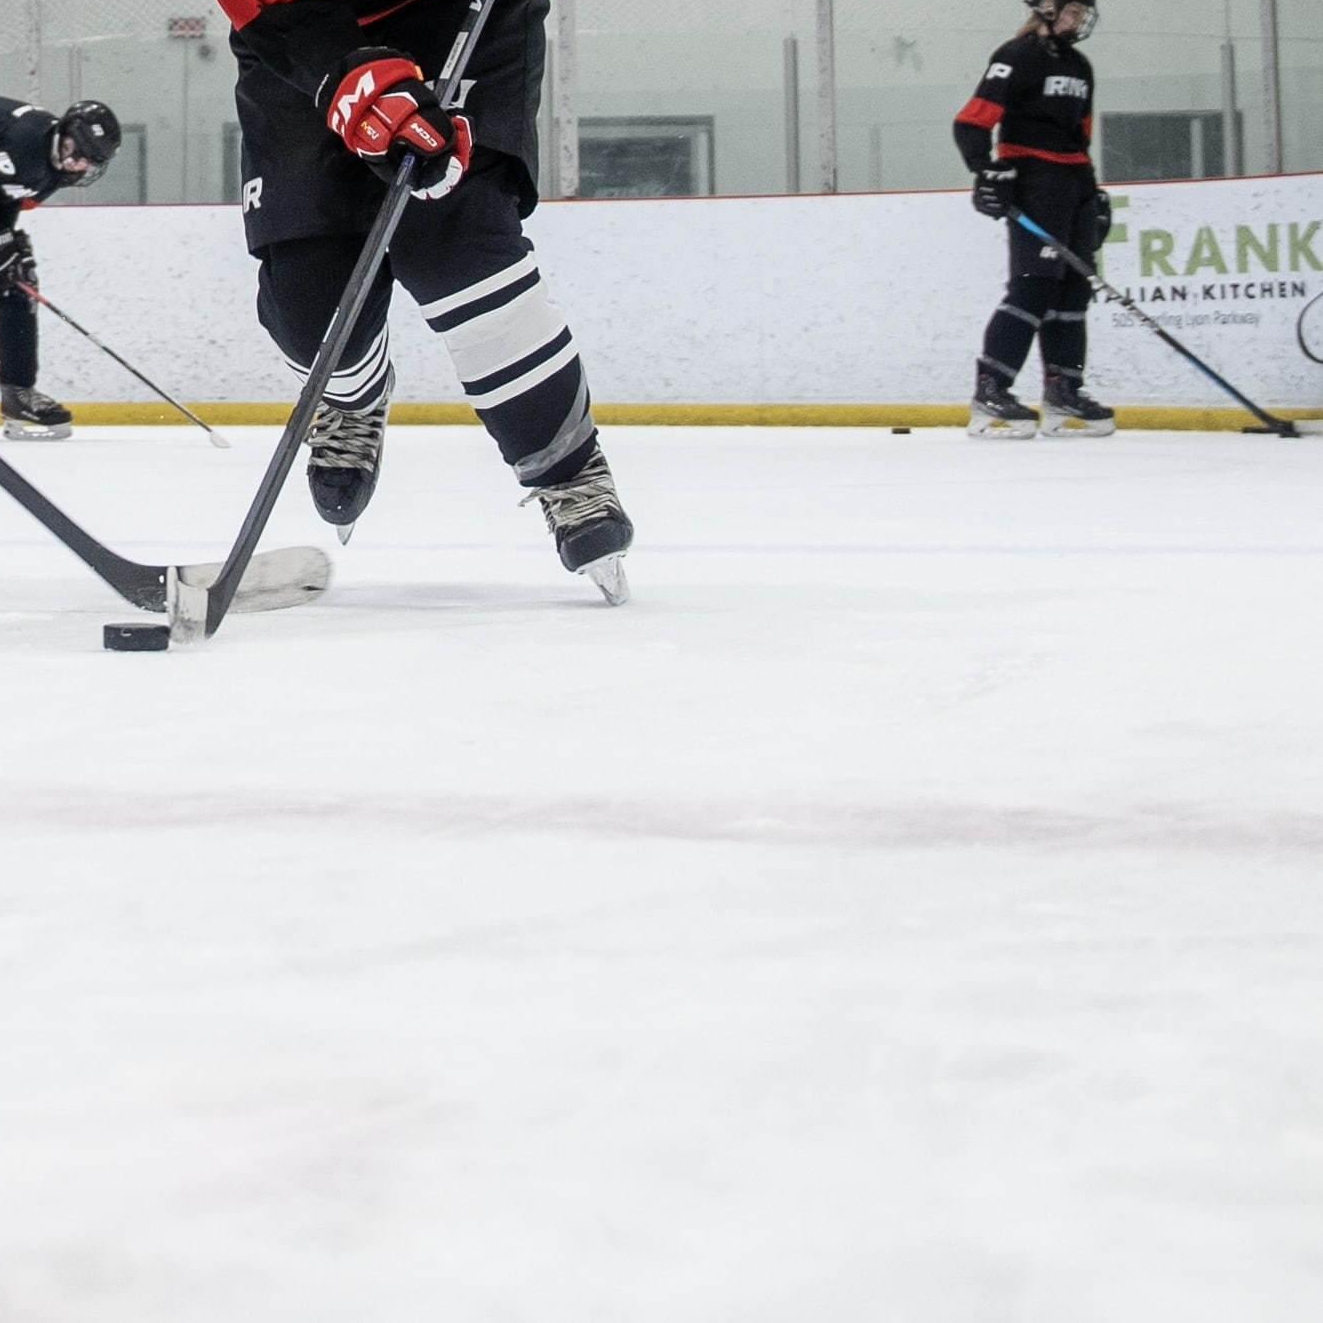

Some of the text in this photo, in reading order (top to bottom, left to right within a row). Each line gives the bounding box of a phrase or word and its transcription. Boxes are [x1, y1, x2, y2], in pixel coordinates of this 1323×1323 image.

[331, 70, 376, 138] CM
[410, 122, 438, 148] CCM
[1201, 280, 1307, 302] KITCHEN
